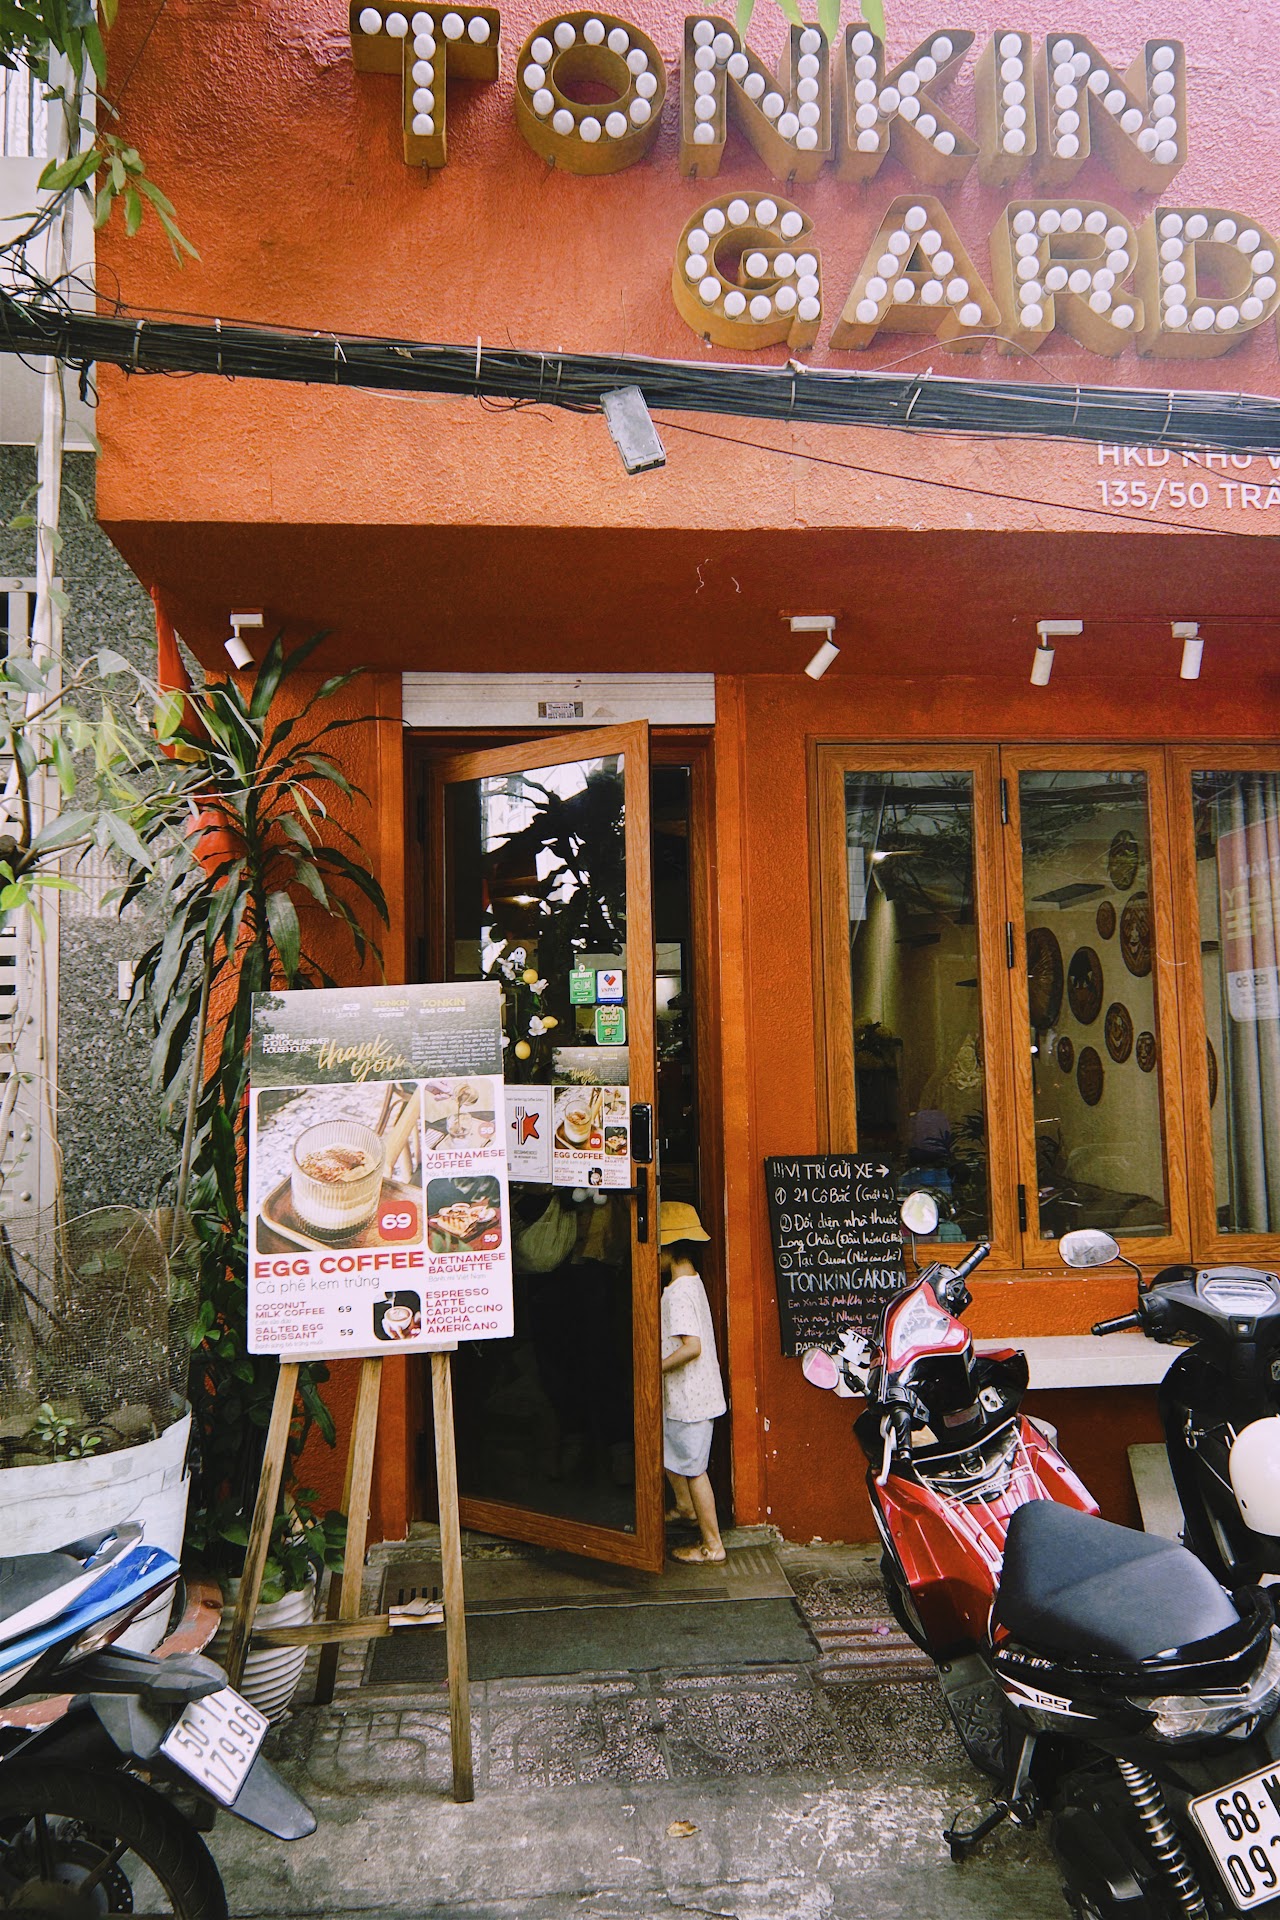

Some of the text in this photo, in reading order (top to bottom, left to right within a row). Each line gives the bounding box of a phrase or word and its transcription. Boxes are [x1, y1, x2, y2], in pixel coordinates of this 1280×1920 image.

[350, 3, 1188, 194] TONKIN
[1097, 441, 1171, 467] HKD
[1097, 478, 1210, 511] 135/50
[421, 998, 466, 1008] TONKIN
[263, 1045, 311, 1054] HOUSEHOLDS
[279, 1039, 301, 1047] LOCAL
[317, 1033, 394, 1070] thank
[350, 1053, 407, 1084] you
[426, 1149, 506, 1161] VIETNAMESE
[554, 1151, 604, 1160] EGG COFFEE
[426, 1160, 473, 1170] COFFEE
[854, 1163, 873, 1179] XE
[381, 1212, 412, 1230] 69
[484, 1233, 499, 1243] 59
[254, 1251, 425, 1279] EGG COFFEE
[428, 1253, 506, 1265] VIETNAMESE
[428, 1262, 493, 1274] BAGUETTE
[255, 1280, 276, 1295] Cà
[280, 1277, 307, 1296] phê
[310, 1277, 340, 1291] kem
[426, 1287, 490, 1300] ESPRESSO
[255, 1301, 307, 1311] COCONUT
[426, 1298, 466, 1308] LATTE
[255, 1305, 353, 1319] MILK COFFEE 69
[426, 1303, 504, 1317] CAPPUCCINO
[426, 1315, 471, 1326] MOCHA
[255, 1323, 324, 1335] SALTED EGG
[427, 1321, 498, 1334] AMERICANO
[255, 1328, 355, 1342] CROISSANT 59
[1035, 1694, 1067, 1711] 125
[203, 1705, 262, 1793] 179.96
[1227, 1835, 1280, 1898] 09
